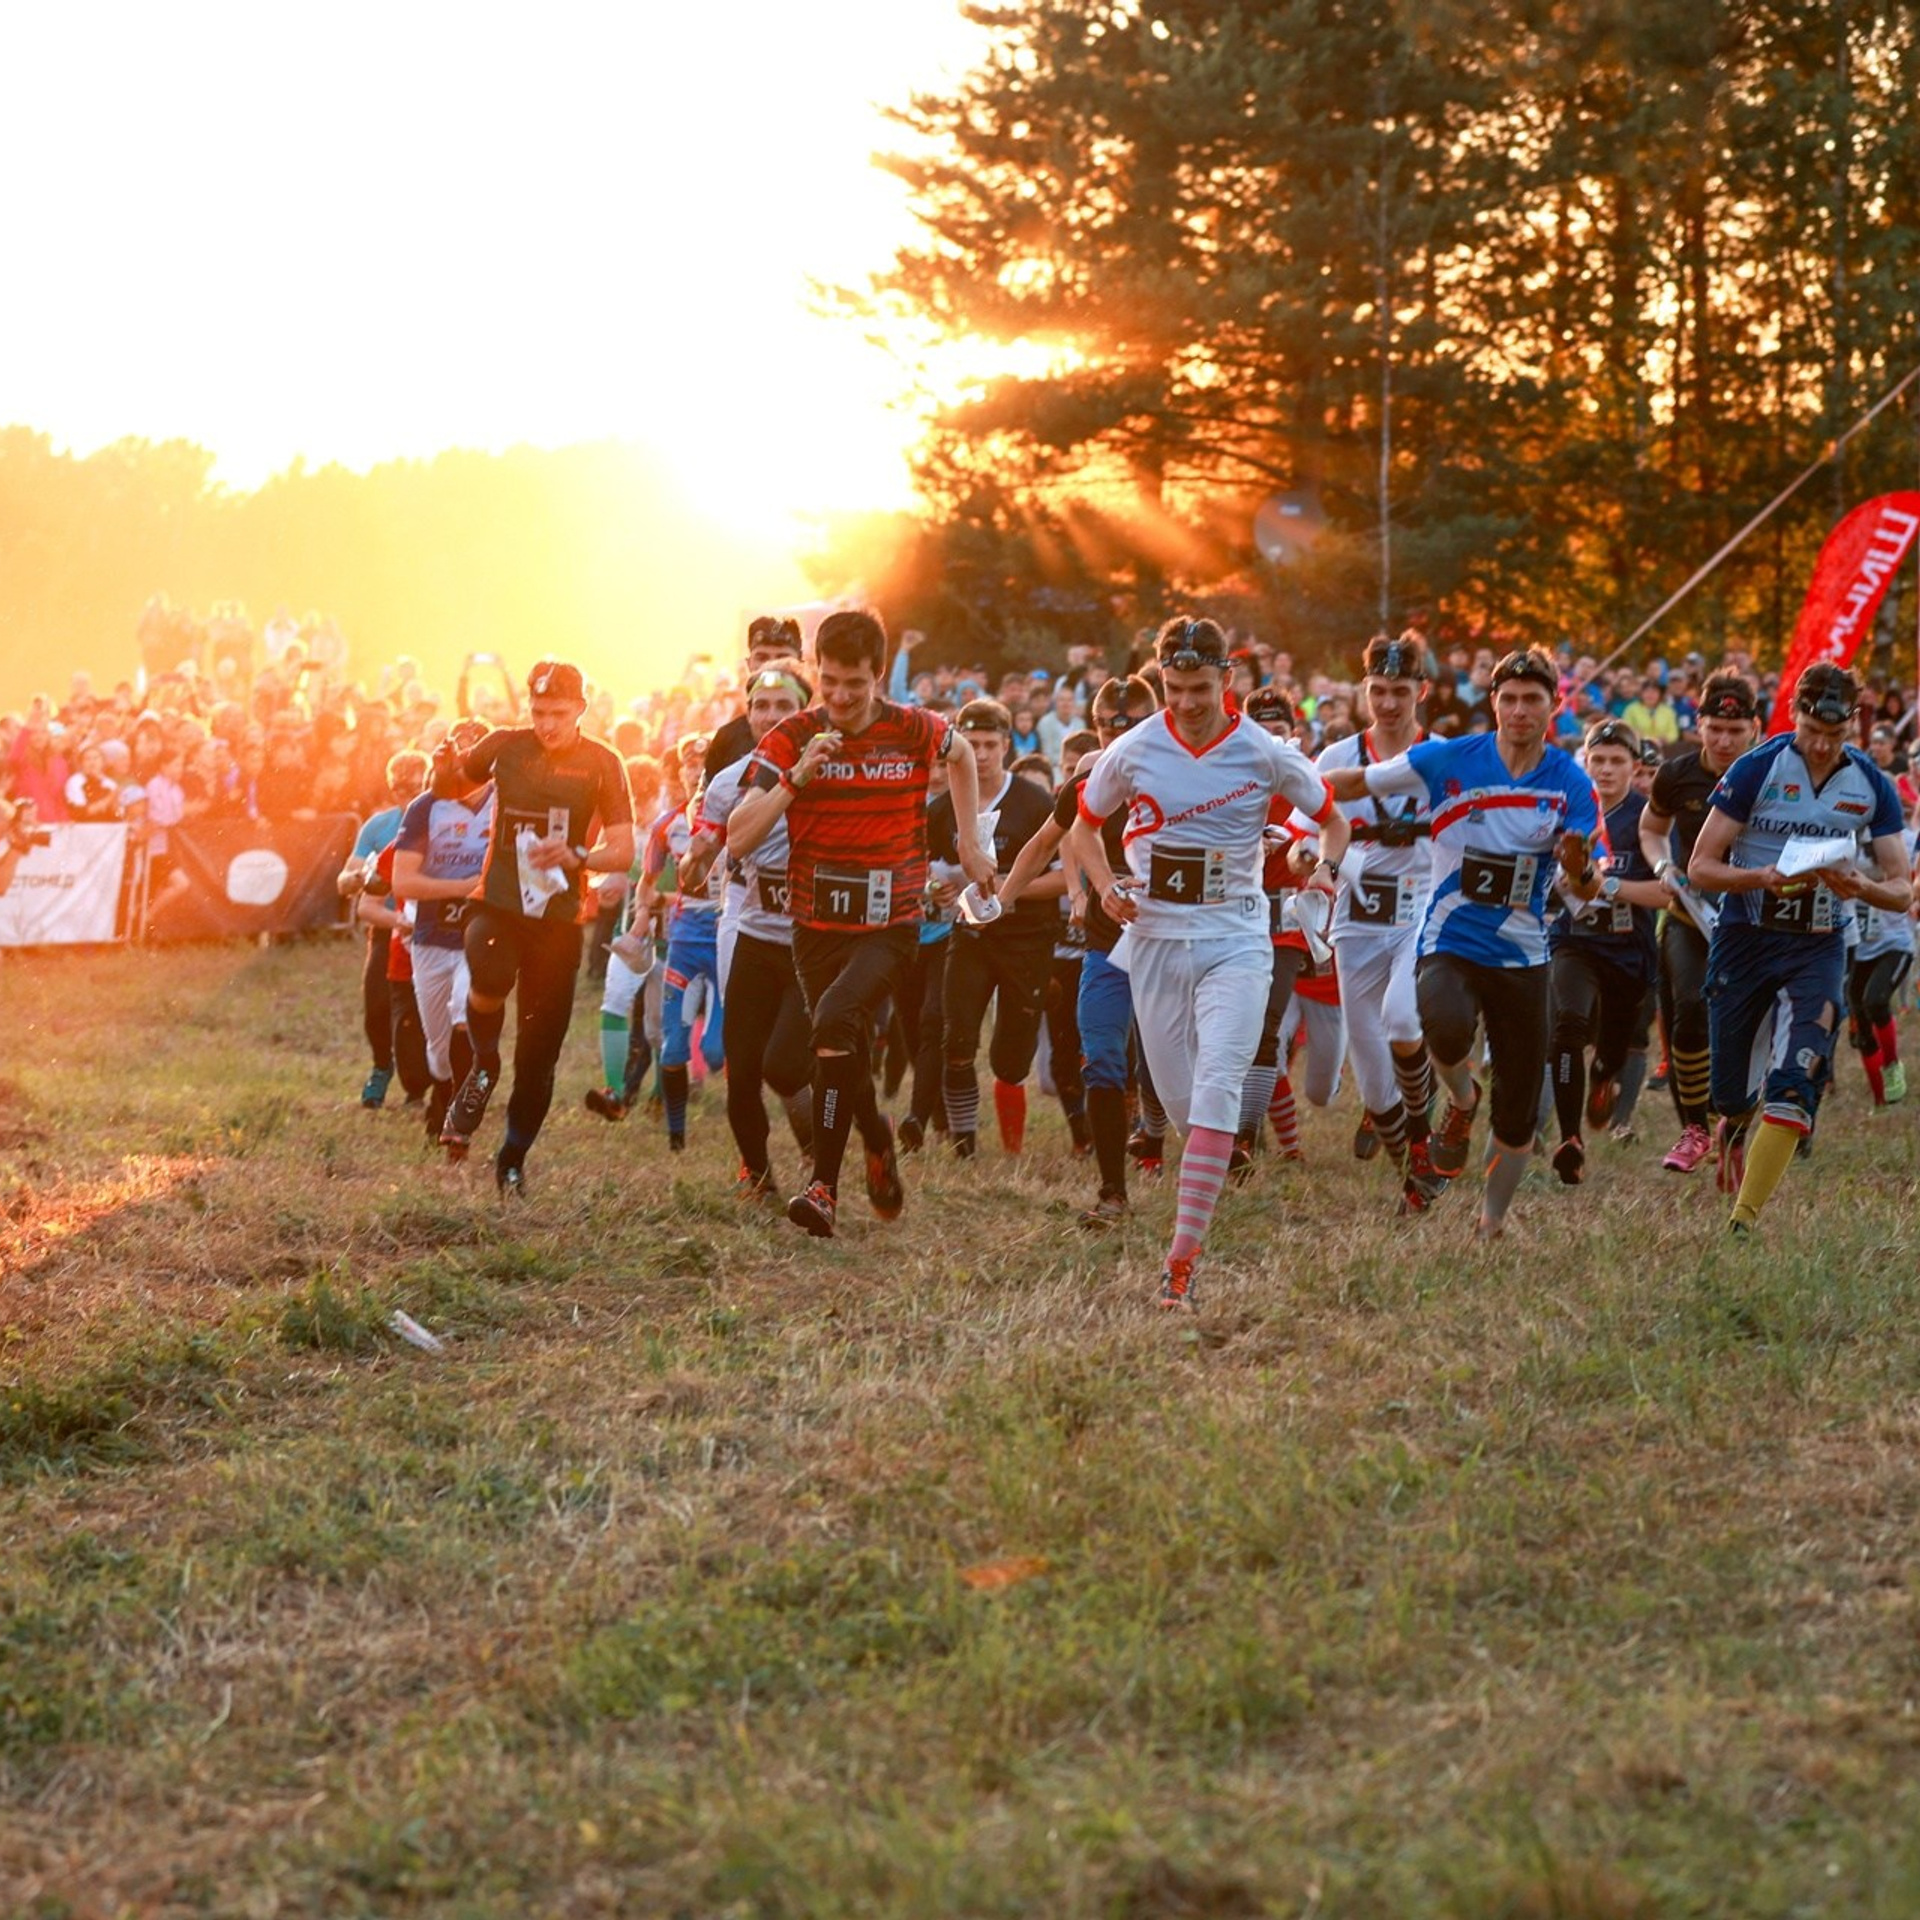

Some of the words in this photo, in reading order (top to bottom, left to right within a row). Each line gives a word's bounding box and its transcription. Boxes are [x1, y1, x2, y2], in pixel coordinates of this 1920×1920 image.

[1822, 507, 1919, 659] ИНИШ
[815, 762, 855, 780] ORD
[861, 762, 916, 780] WEST
[1166, 869, 1186, 894] 4
[1476, 869, 1495, 894] 2
[829, 889, 851, 914] 11
[1365, 892, 1382, 915] 5
[1774, 897, 1803, 920] 21
